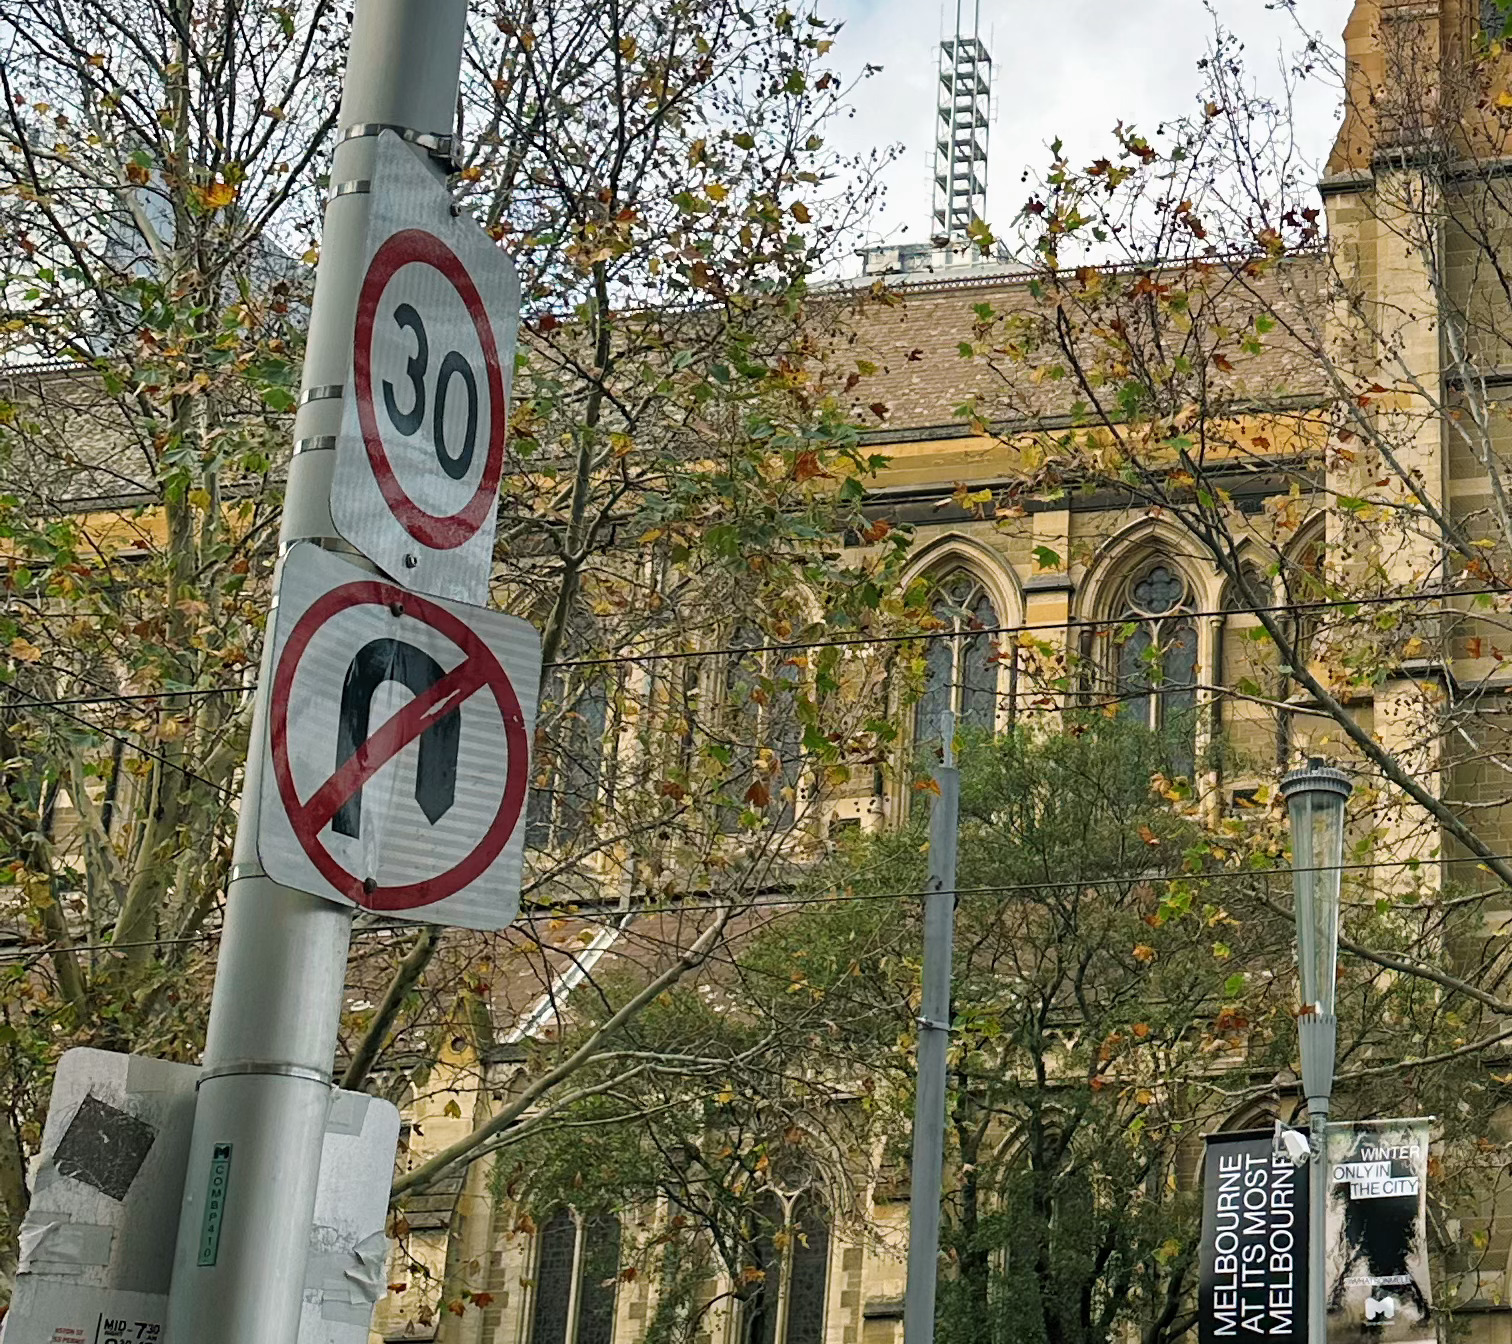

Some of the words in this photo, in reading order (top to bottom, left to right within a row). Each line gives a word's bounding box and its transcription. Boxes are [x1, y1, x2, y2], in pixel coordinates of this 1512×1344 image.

[383, 303, 478, 480] 30
[1333, 1164, 1373, 1181] ONLY
[1375, 1163, 1391, 1178] IN
[1360, 1145, 1420, 1161] WINTER
[1242, 1153, 1268, 1234] MOST
[1351, 1181, 1380, 1196] THE
[1382, 1179, 1419, 1195] CITY
[1213, 1153, 1242, 1336] MELBOURNE
[1269, 1150, 1295, 1335] MELBOURNE
[1241, 1243, 1266, 1288] ITS
[104, 1318, 127, 1332] MID
[1241, 1297, 1265, 1334] AT
